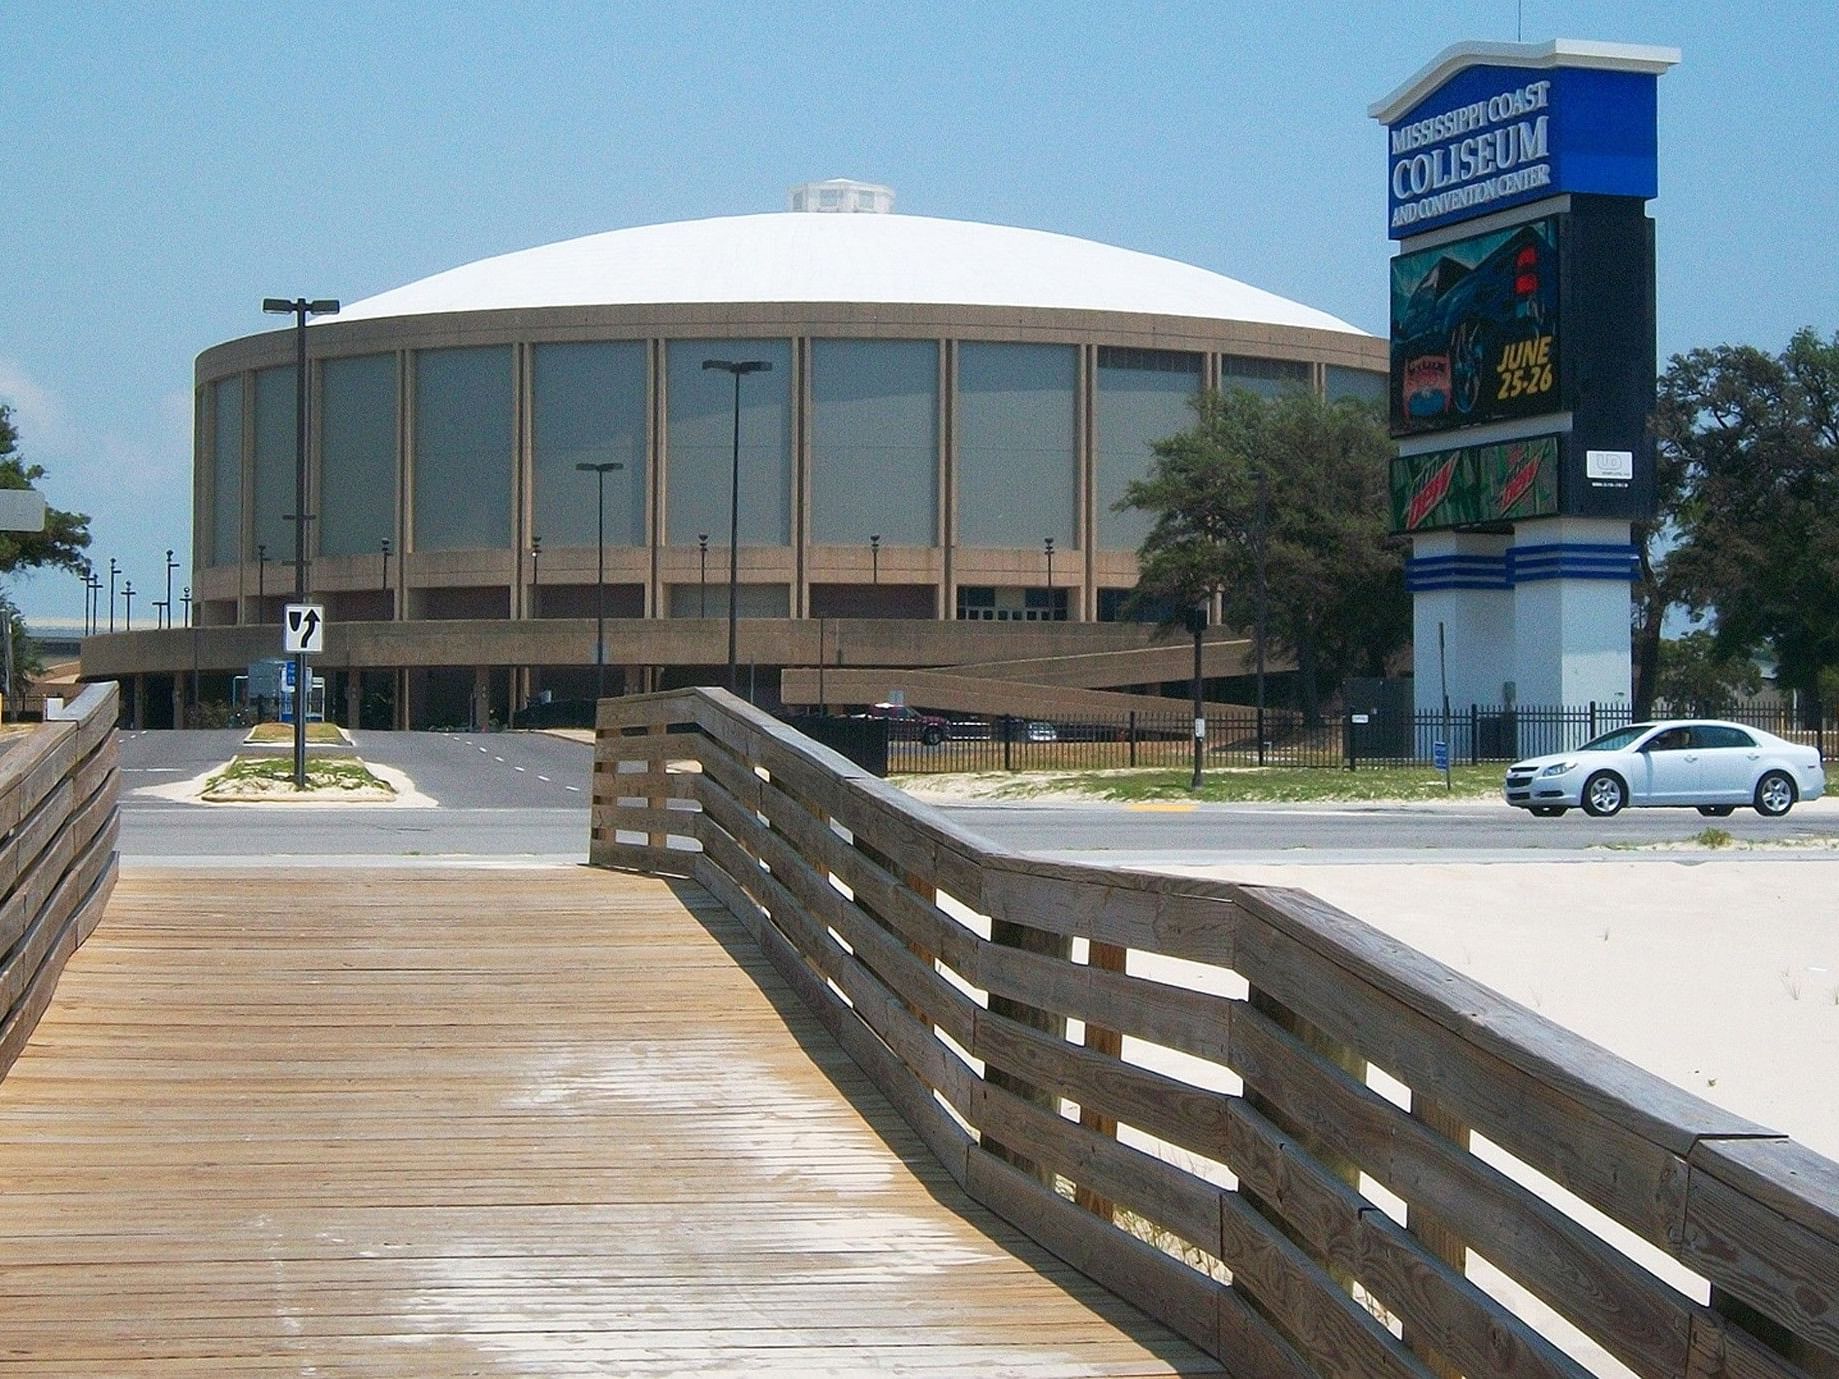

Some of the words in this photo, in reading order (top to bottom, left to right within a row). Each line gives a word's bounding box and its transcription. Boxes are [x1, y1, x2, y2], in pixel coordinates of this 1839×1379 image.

[1391, 101, 1488, 154] MISSISSIPPI
[1488, 81, 1549, 122] COAST
[1393, 116, 1549, 199] COLISEUM
[1392, 203, 1419, 227] AND
[1419, 179, 1498, 218] CONVENTION
[1499, 164, 1550, 195] CENTER
[1497, 336, 1552, 372] JUNE
[1497, 364, 1553, 399] 25-26
